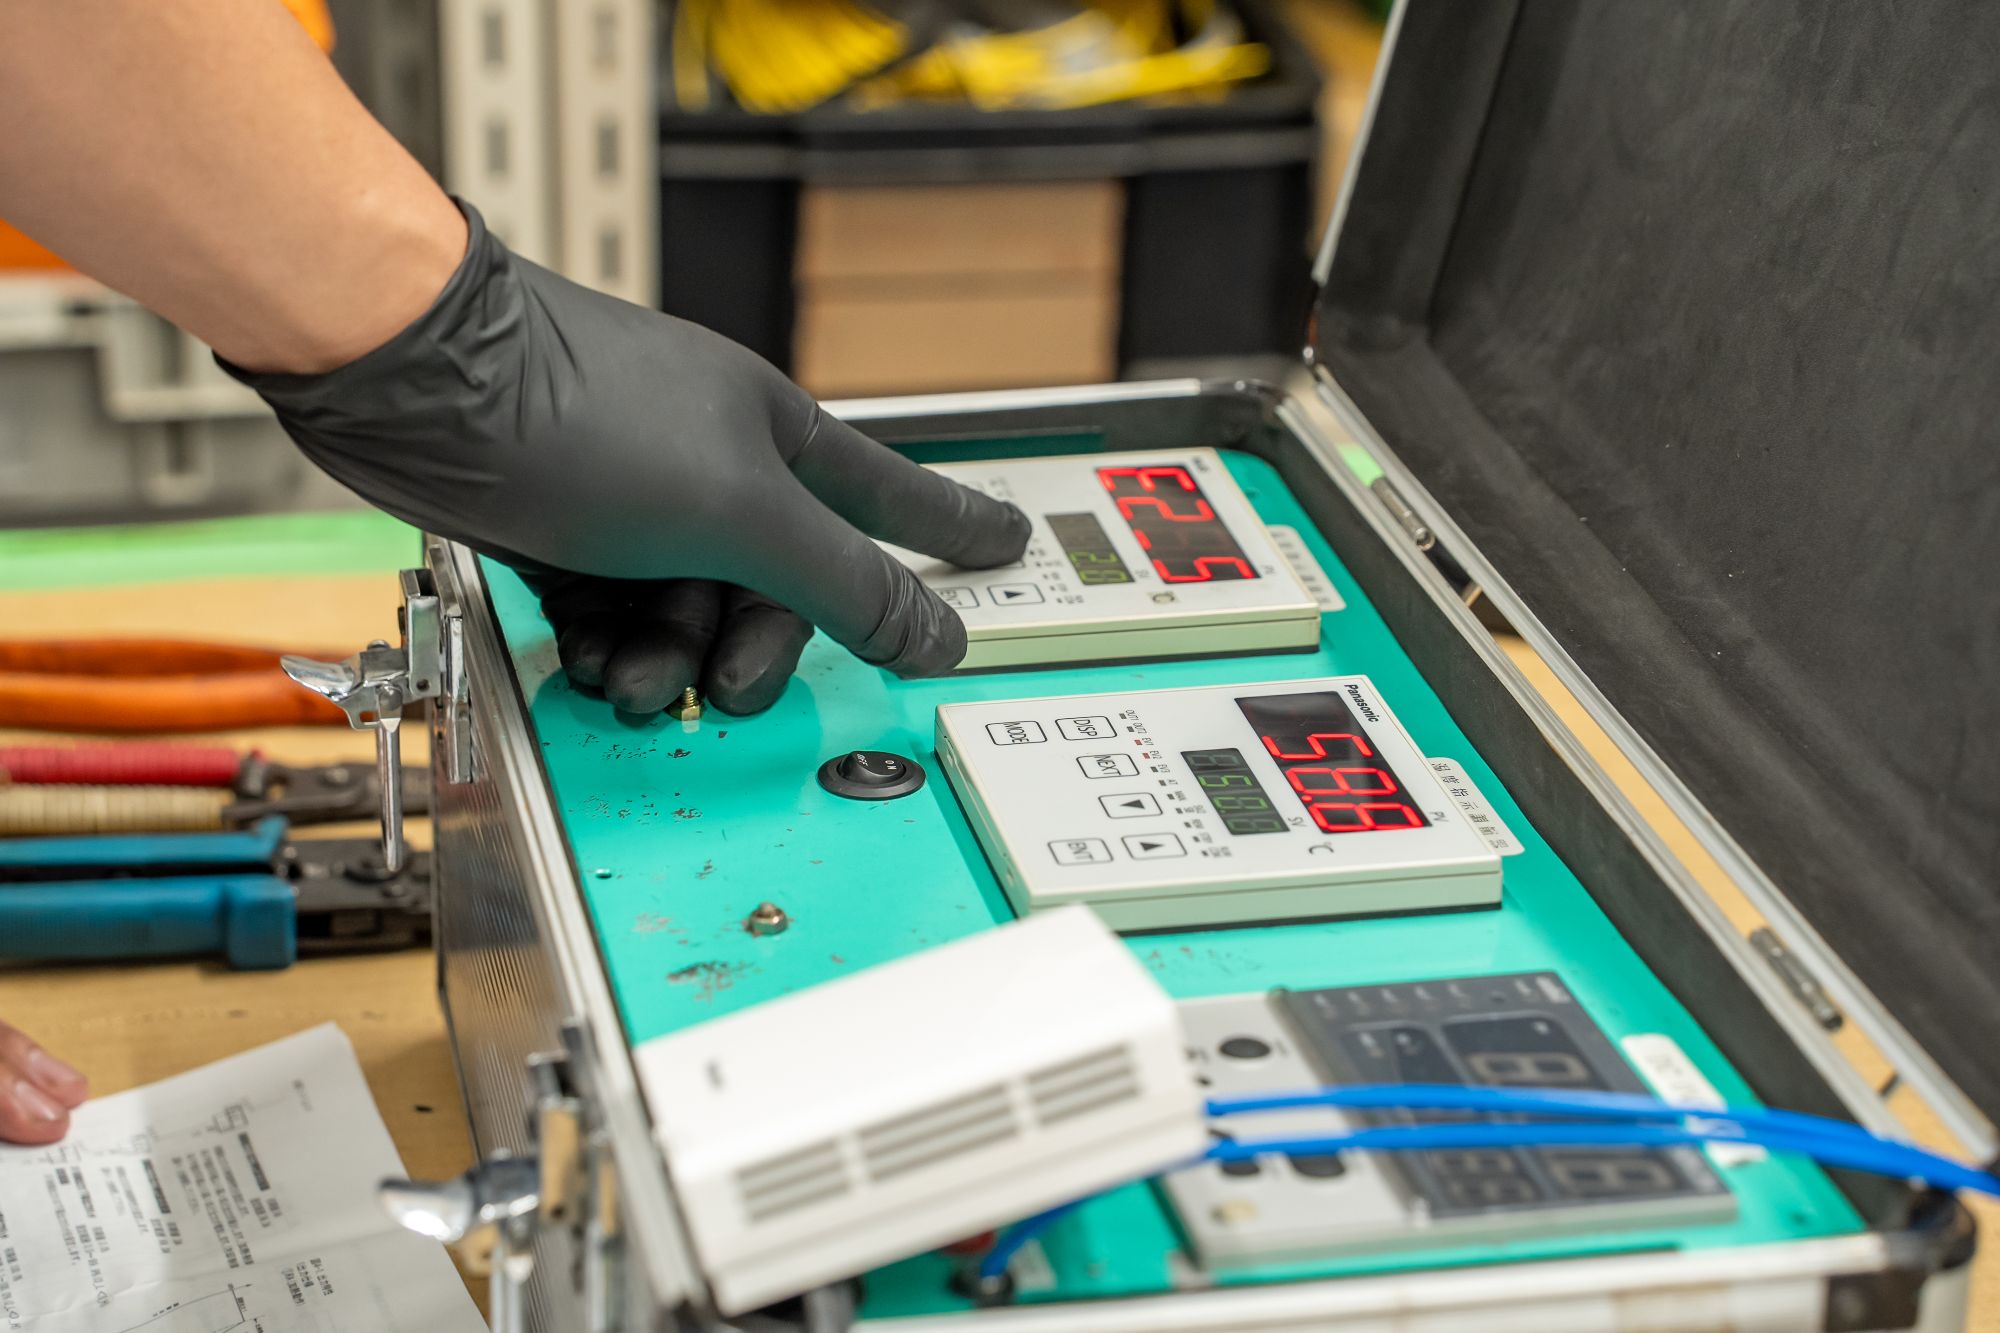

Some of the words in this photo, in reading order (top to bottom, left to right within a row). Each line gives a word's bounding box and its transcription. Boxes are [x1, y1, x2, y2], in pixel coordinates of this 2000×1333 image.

[1343, 684, 1380, 723] Panasonic
[1125, 709, 1139, 721] OUT1
[1003, 722, 1029, 743] MODE
[1073, 719, 1098, 737] DISP
[1142, 737, 1155, 746] EV1
[884, 760, 897, 770] ON
[1094, 755, 1122, 776] NEXT
[1261, 733, 1424, 832] 58.8
[1287, 816, 1308, 827] SV
[1429, 811, 1450, 822] PV
[1067, 842, 1095, 861] ENT
